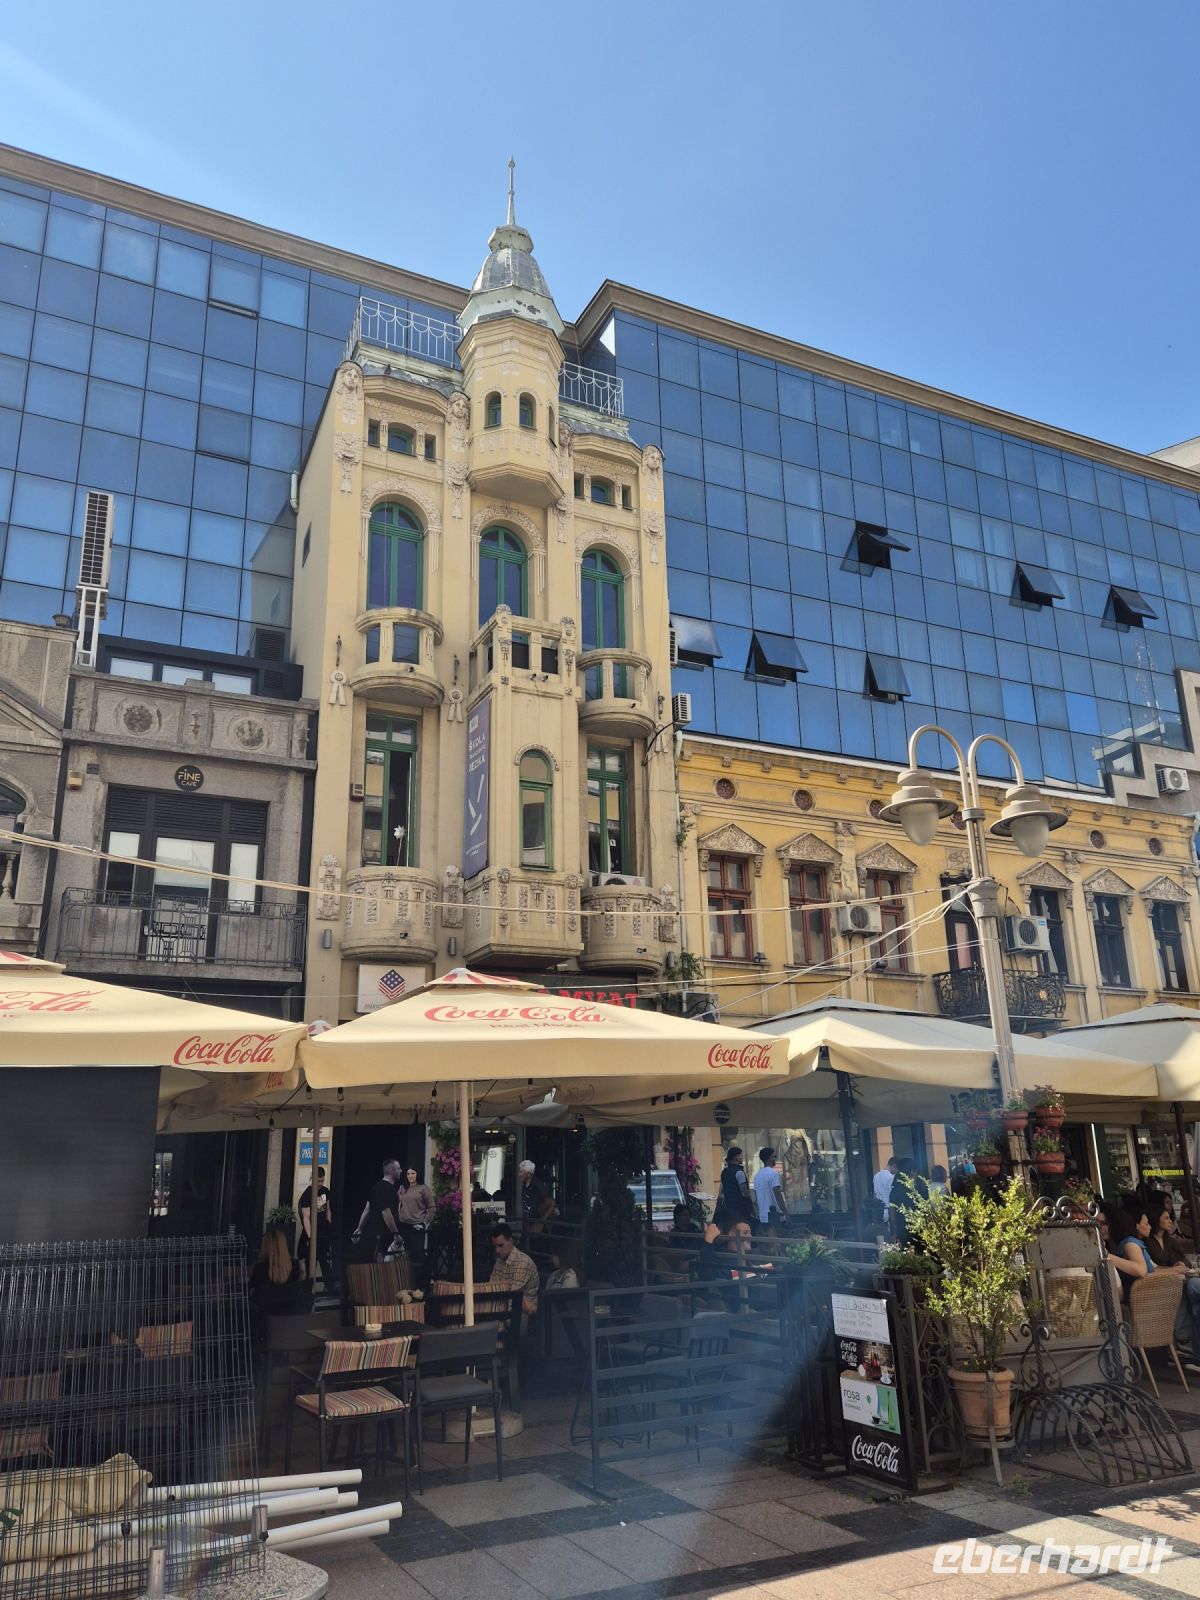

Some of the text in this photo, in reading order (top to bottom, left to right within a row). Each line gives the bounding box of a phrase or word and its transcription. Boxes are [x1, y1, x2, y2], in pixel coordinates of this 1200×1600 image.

[424, 1005, 606, 1023] Coca-Cola
[173, 1034, 280, 1066] Coca-Cola
[708, 1043, 772, 1069] Coca-Cola
[843, 1389, 860, 1401] rosa
[851, 1434, 900, 1473] Coca-Cola
